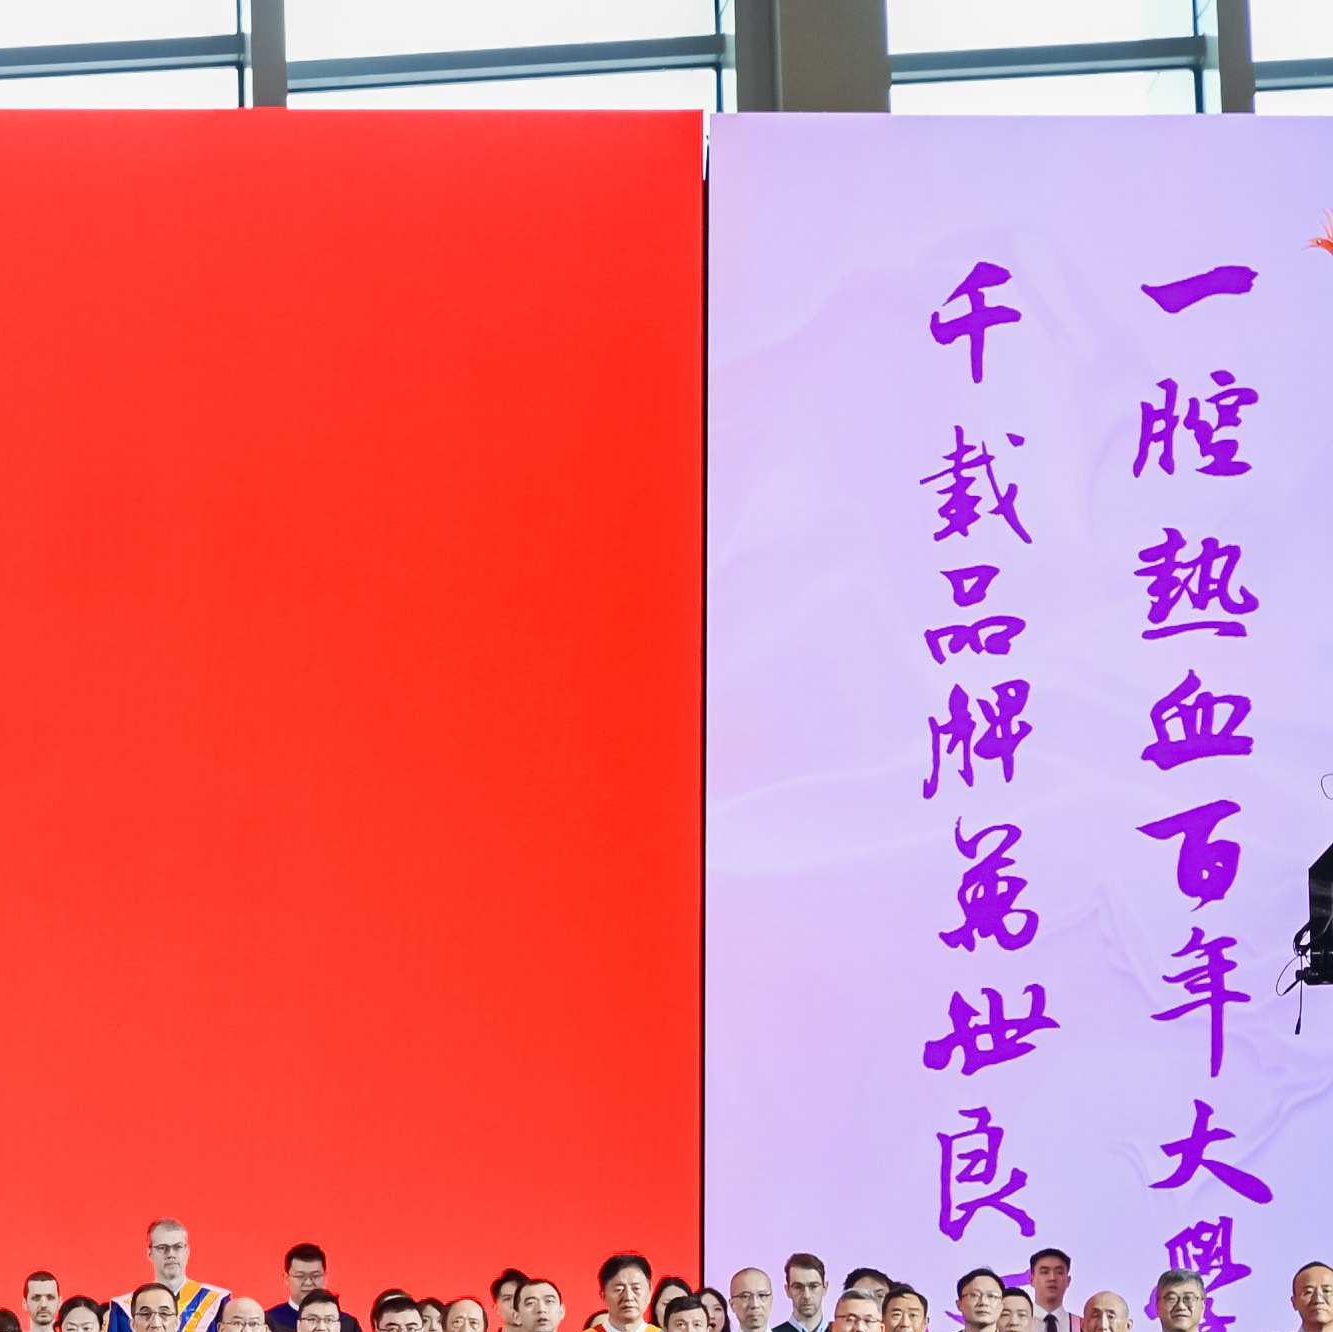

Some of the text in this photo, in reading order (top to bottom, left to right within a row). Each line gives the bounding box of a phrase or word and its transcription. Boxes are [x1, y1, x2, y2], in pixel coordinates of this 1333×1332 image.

[920, 262, 1060, 1326] 千載品牌萬世良
